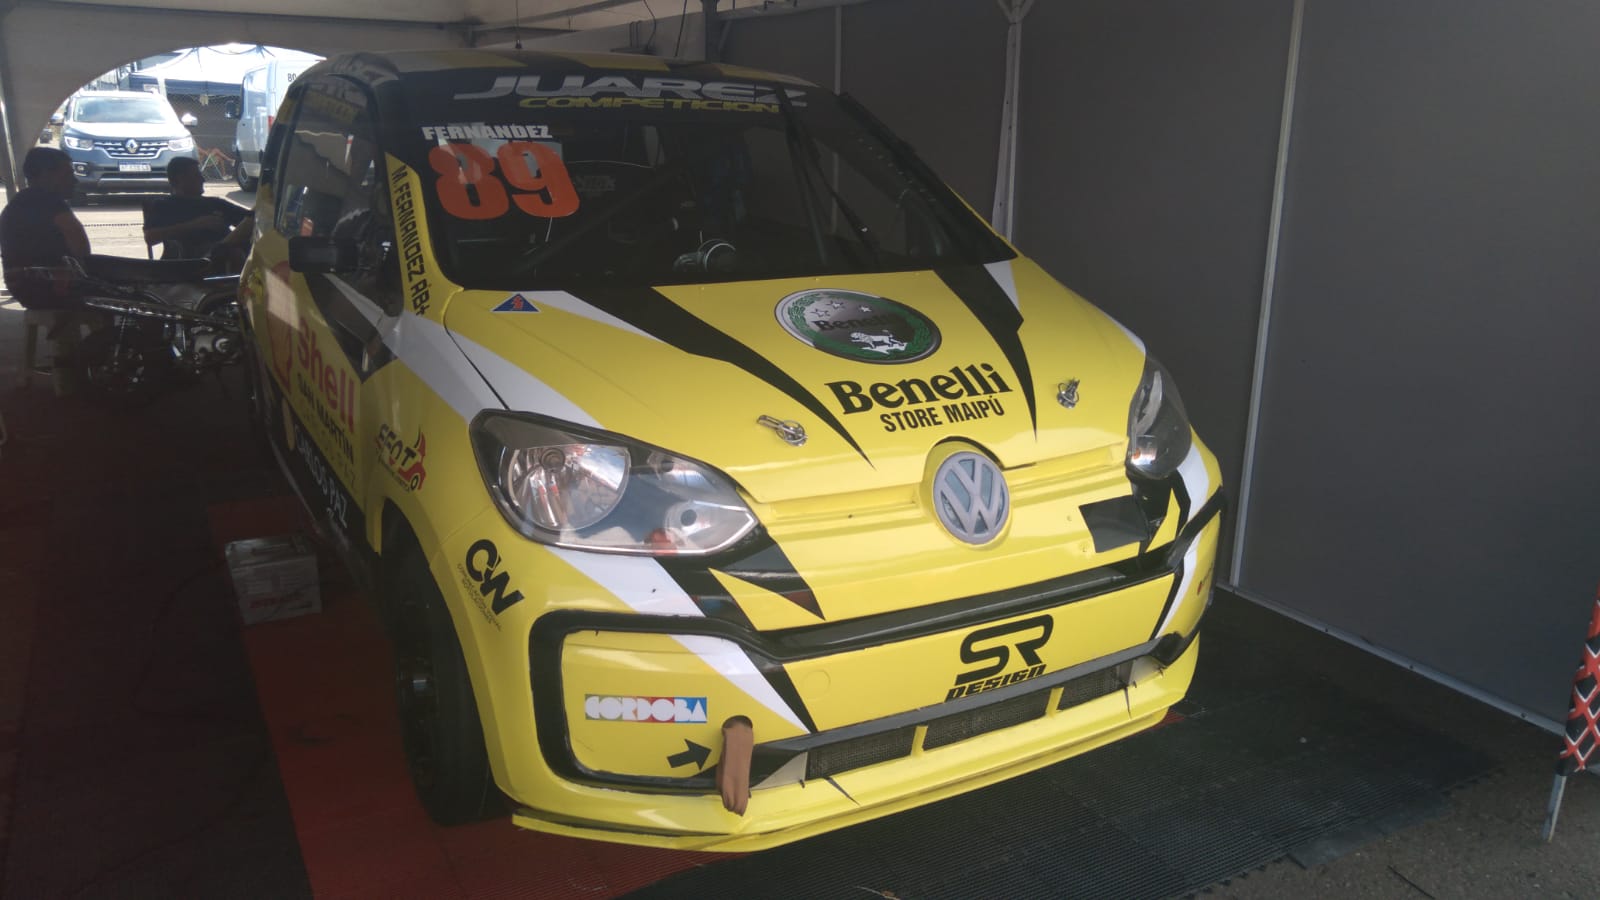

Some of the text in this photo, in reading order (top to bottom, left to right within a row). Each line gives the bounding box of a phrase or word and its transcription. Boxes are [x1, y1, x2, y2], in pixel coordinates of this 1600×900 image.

[453, 75, 807, 108] JUAREZ
[518, 96, 779, 113] COMPETICION
[421, 124, 553, 140] FERNANDEZ
[428, 140, 580, 220] 89
[297, 316, 355, 434] Shell
[824, 363, 1013, 414] Benelli
[880, 395, 1005, 432] STORE MAIPÚ
[954, 613, 1054, 686] SR
[944, 664, 1047, 702] DESIGN
[585, 695, 707, 722] CORDOBA
